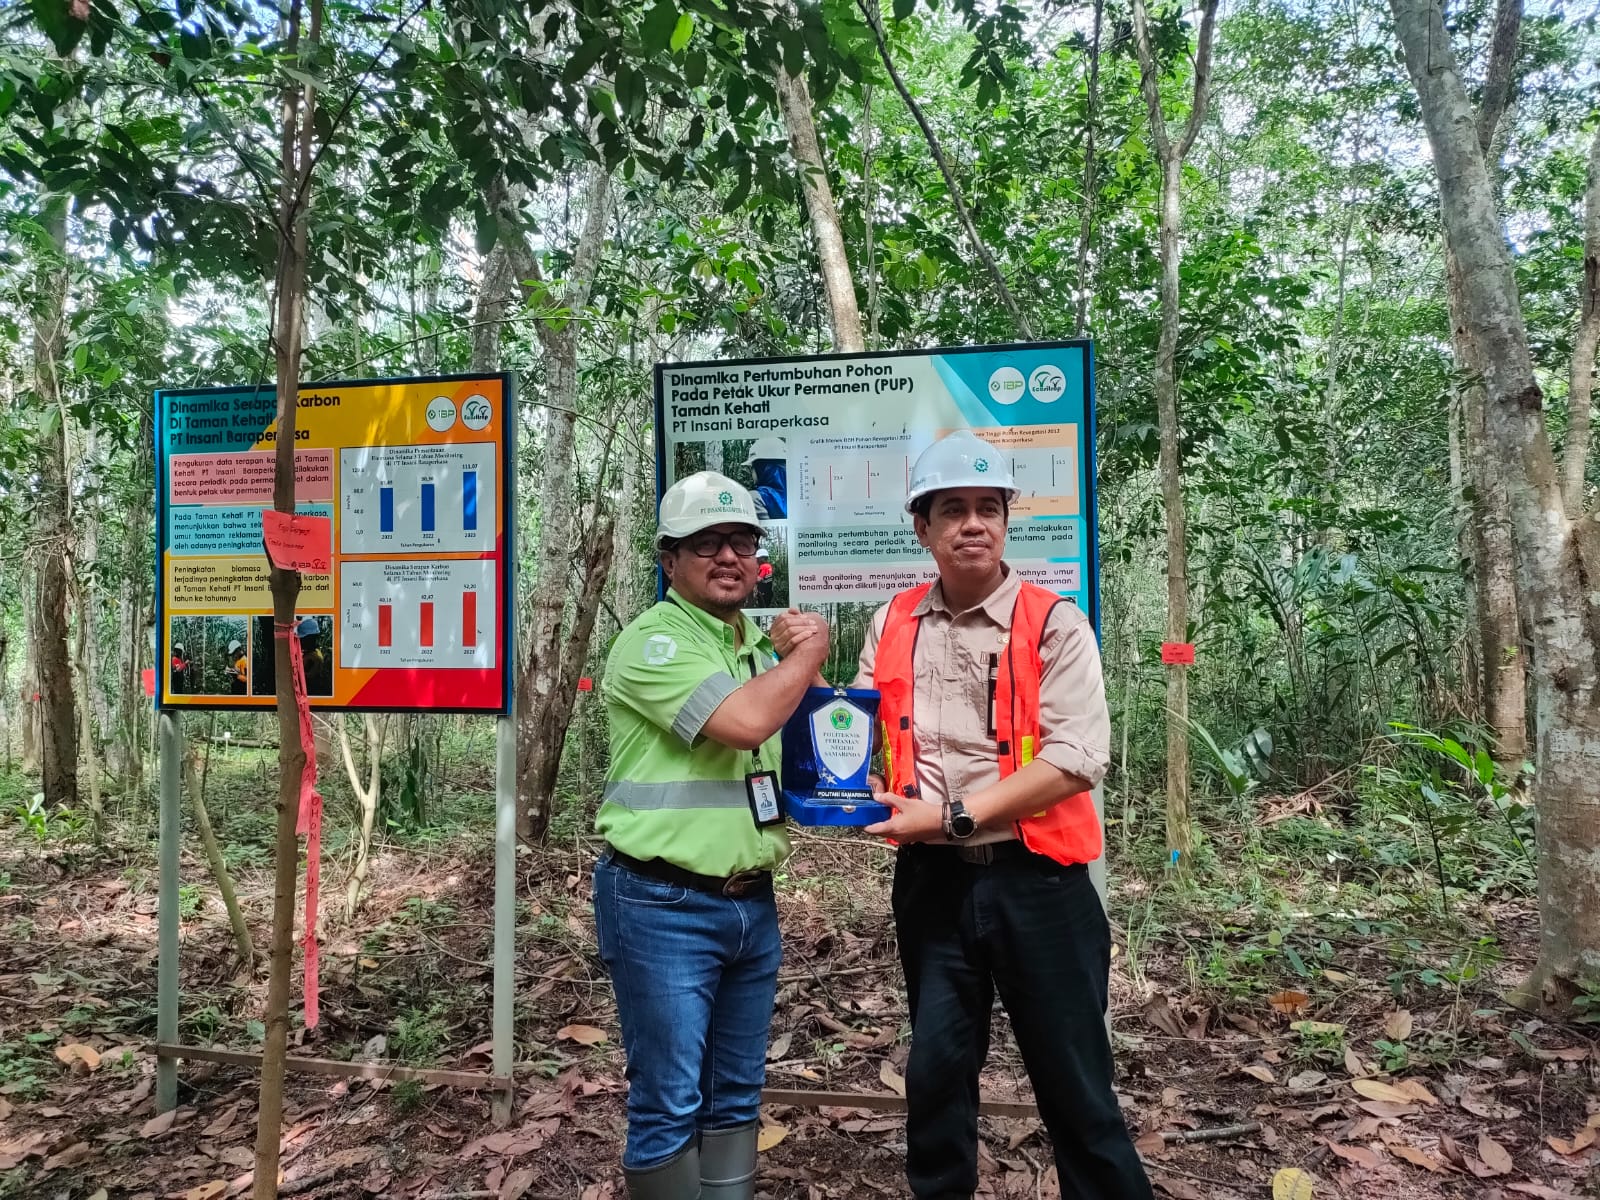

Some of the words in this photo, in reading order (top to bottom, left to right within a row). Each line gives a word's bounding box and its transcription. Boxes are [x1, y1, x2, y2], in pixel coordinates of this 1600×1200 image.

[672, 372, 738, 386] Dinamika
[744, 367, 841, 383] Pertumbuhan
[846, 364, 893, 376] Pohon
[672, 387, 708, 402] Pada
[713, 385, 753, 400] Petak
[758, 382, 789, 397] Ukur
[795, 380, 869, 395] Permanen
[875, 377, 914, 394] (PUP)
[170, 401, 229, 413] Dinamika
[234, 399, 277, 411] Serapa
[672, 403, 719, 417] Taman
[725, 401, 770, 415] Kehati
[170, 417, 181, 429] Di
[186, 416, 228, 428] Taman
[232, 414, 272, 426] Kehati
[673, 420, 686, 432] PT
[691, 418, 732, 431] Insani
[737, 415, 829, 431] Baraperkasa
[170, 433, 182, 445] PT
[186, 431, 222, 444] Insani
[227, 430, 309, 444] Barapersa
[174, 460, 213, 468] Pengukuran
[236, 458, 264, 466] serapan
[243, 467, 276, 475] Baraperk
[200, 479, 226, 487] periodik
[174, 522, 219, 531] menunjukkan
[838, 530, 888, 538] pertumbuhan
[191, 541, 216, 550] adanya
[218, 540, 261, 549] peningkatan
[870, 572, 916, 580] menunjukan
